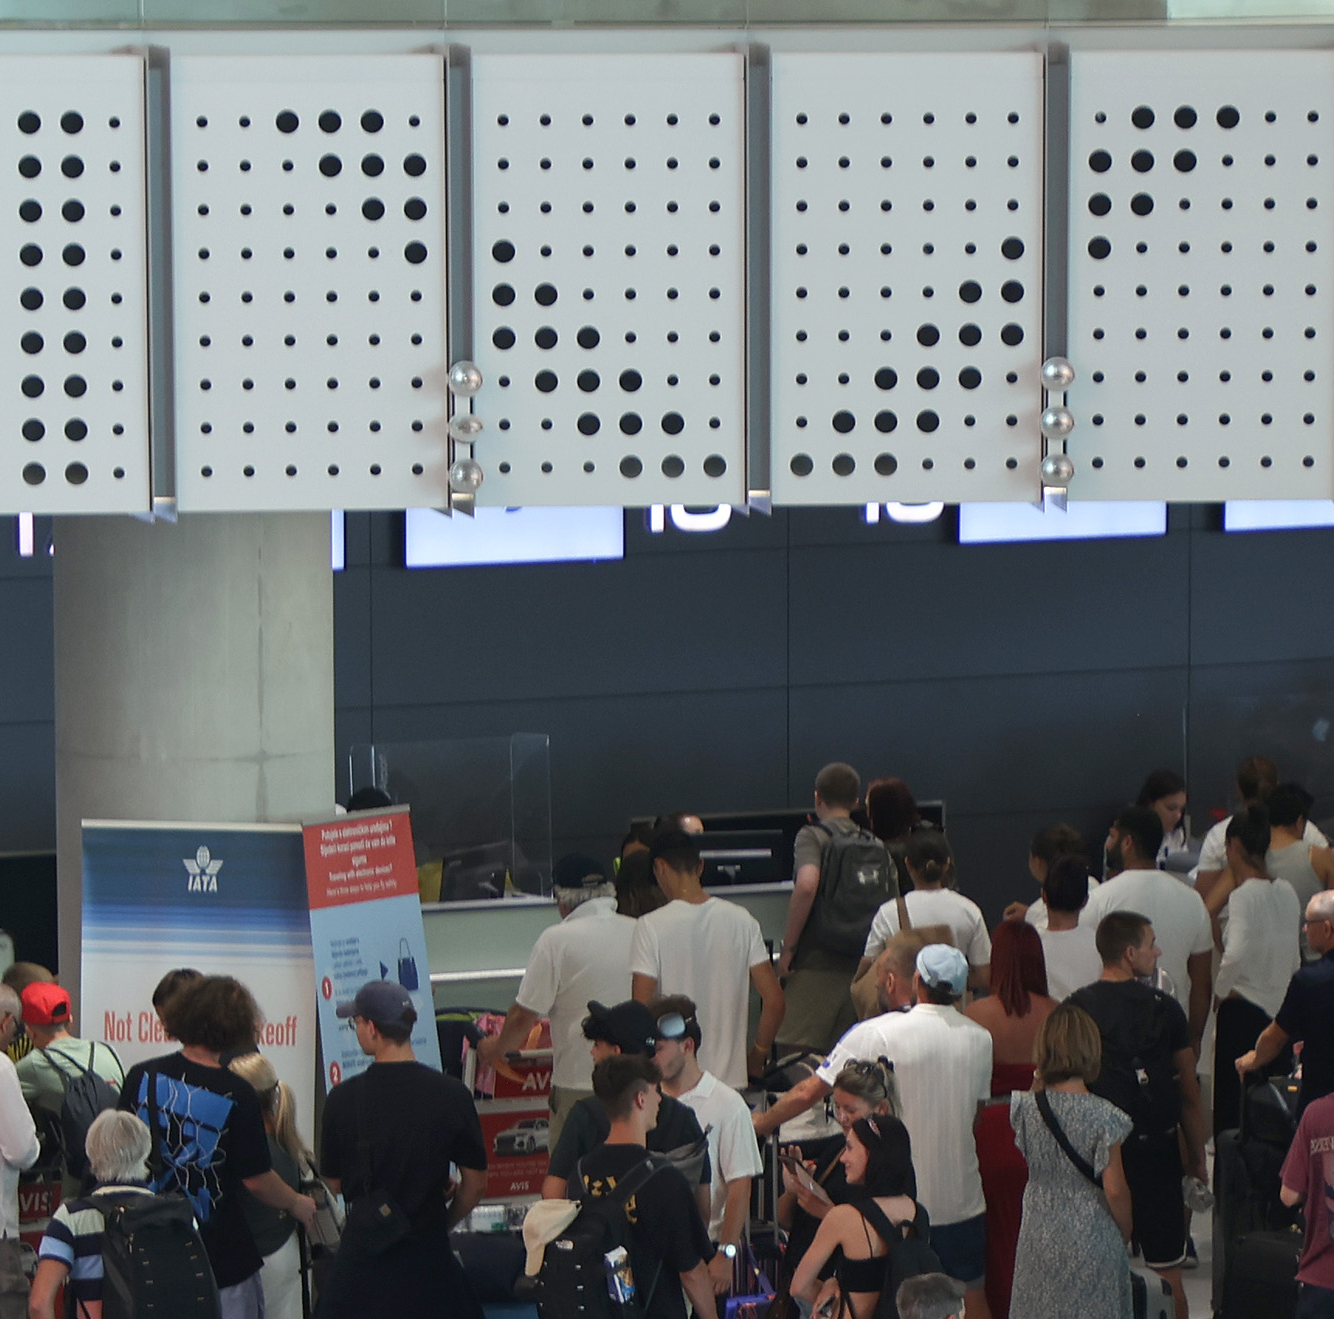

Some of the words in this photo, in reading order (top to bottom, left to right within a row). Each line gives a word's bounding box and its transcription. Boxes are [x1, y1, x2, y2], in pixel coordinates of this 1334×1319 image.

[187, 874, 219, 893] IATA
[104, 1010, 133, 1042] Not
[255, 1015, 298, 1046] keoff
